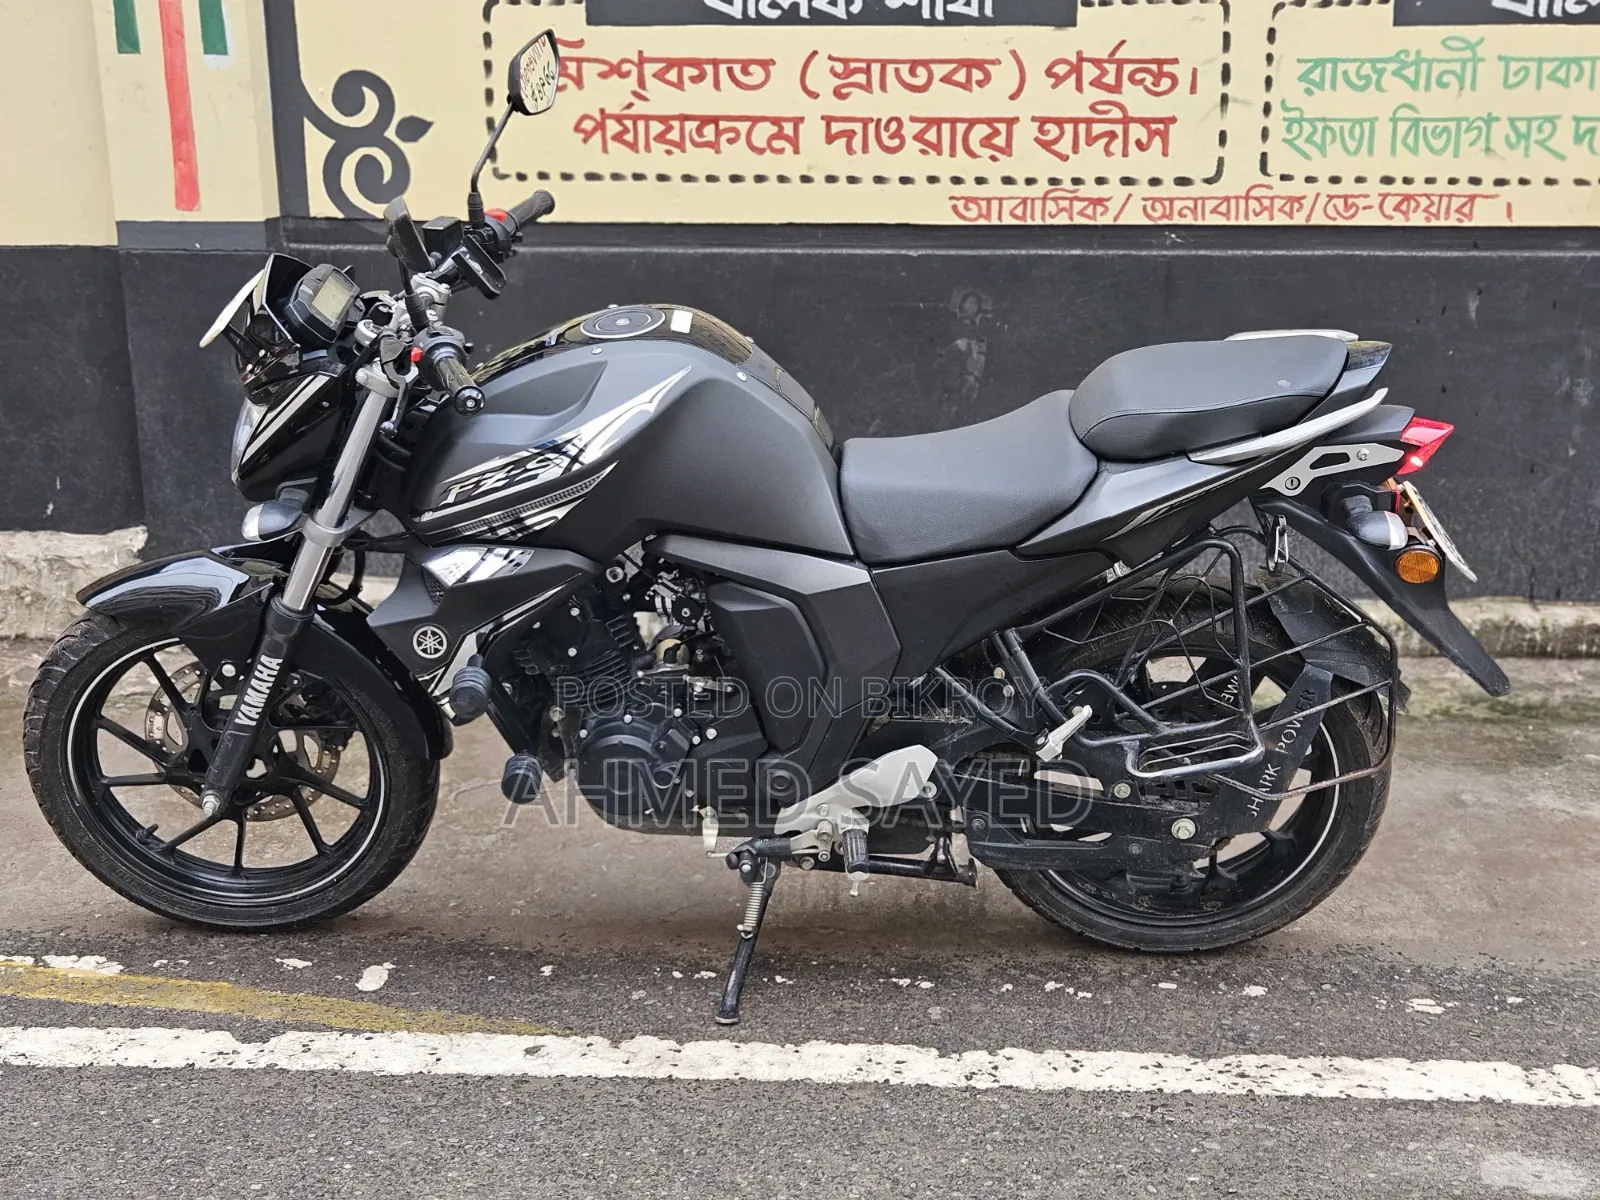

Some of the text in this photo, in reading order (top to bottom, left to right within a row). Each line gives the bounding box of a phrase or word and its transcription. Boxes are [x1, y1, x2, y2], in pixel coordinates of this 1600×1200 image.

[1297, 36, 1486, 97] রাজধানী
[573, 99, 1178, 162] পর্যায়ক্রমে দাওরায়ে হাদীস
[1280, 98, 1379, 161] ইফতা
[234, 654, 284, 727] YAMAHA
